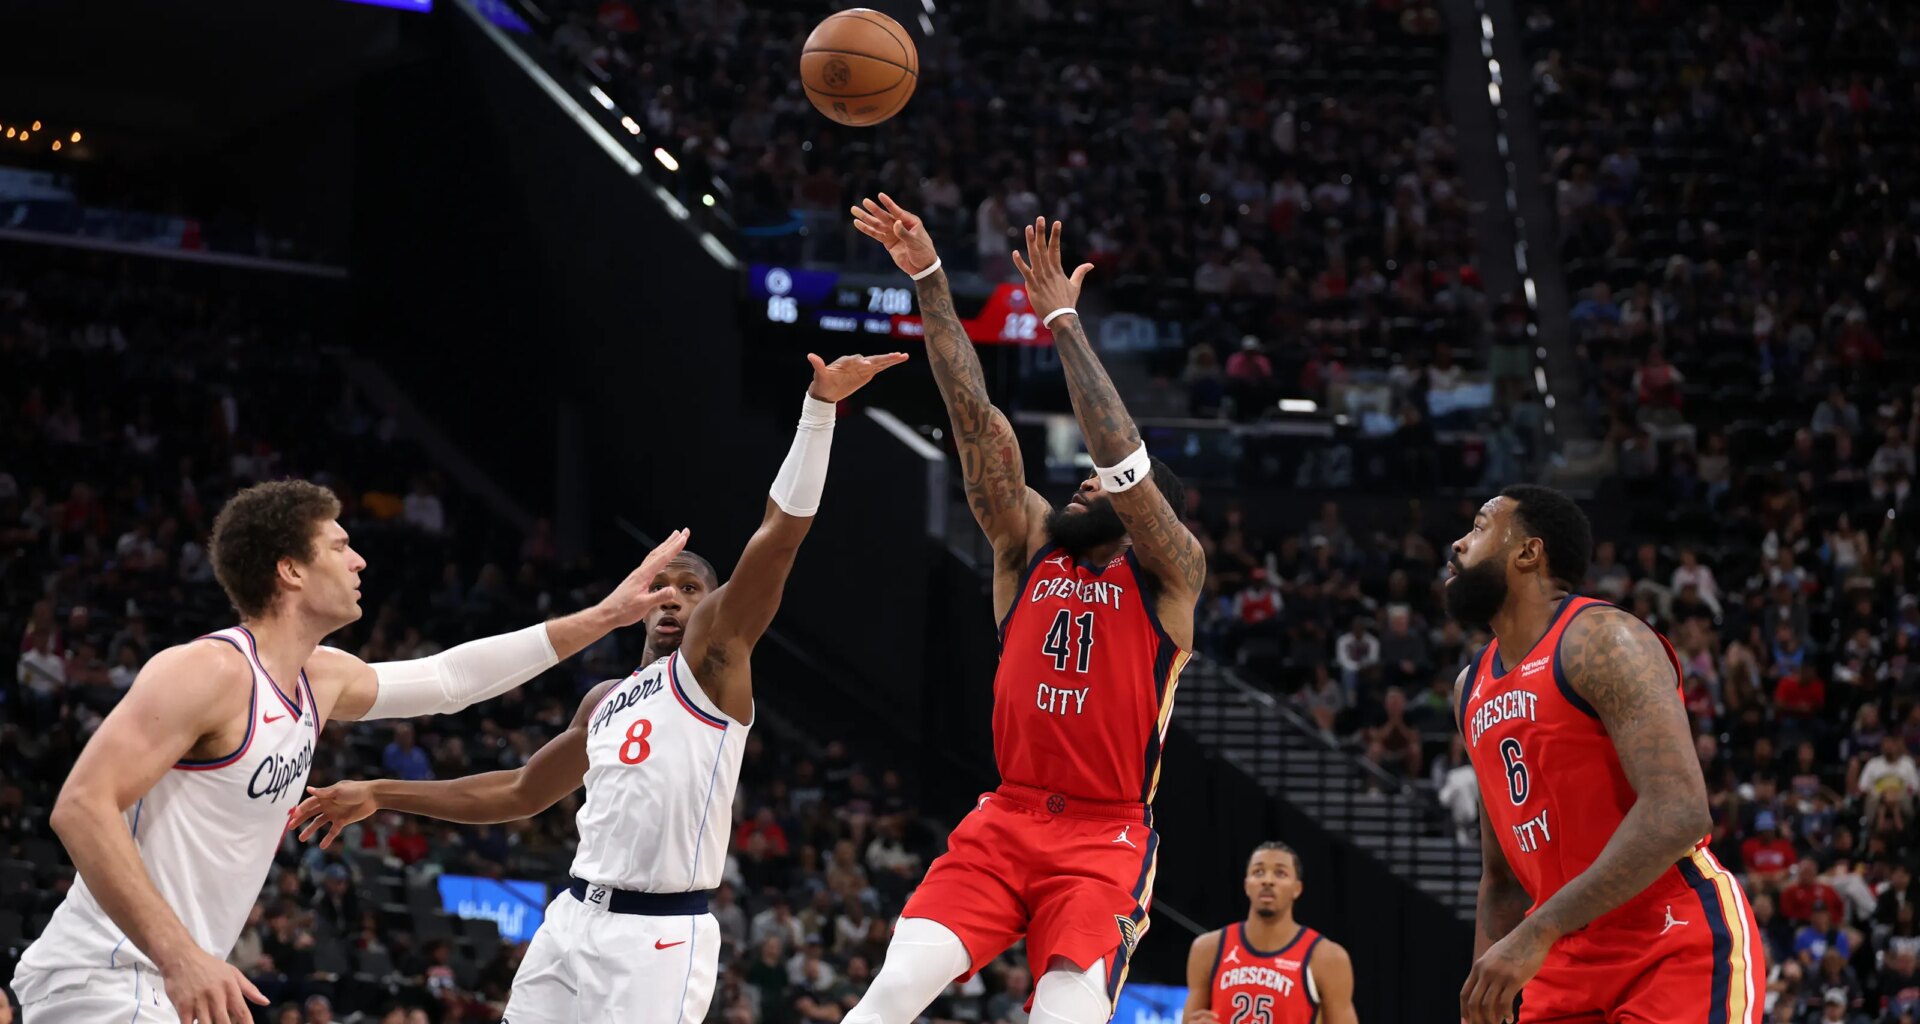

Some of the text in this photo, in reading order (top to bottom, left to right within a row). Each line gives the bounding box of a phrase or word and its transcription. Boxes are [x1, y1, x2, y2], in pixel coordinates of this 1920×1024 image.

[1042, 608, 1094, 674] 41
[1036, 682, 1089, 715] CITY
[1470, 690, 1538, 748] CRESCENT
[618, 718, 652, 765] 8
[247, 739, 313, 804] Clippers
[1500, 737, 1530, 806] 6
[1512, 809, 1551, 853] CITY
[588, 887, 606, 904] LA
[1220, 966, 1294, 998] CRESCENT
[1231, 991, 1275, 1024] 25
